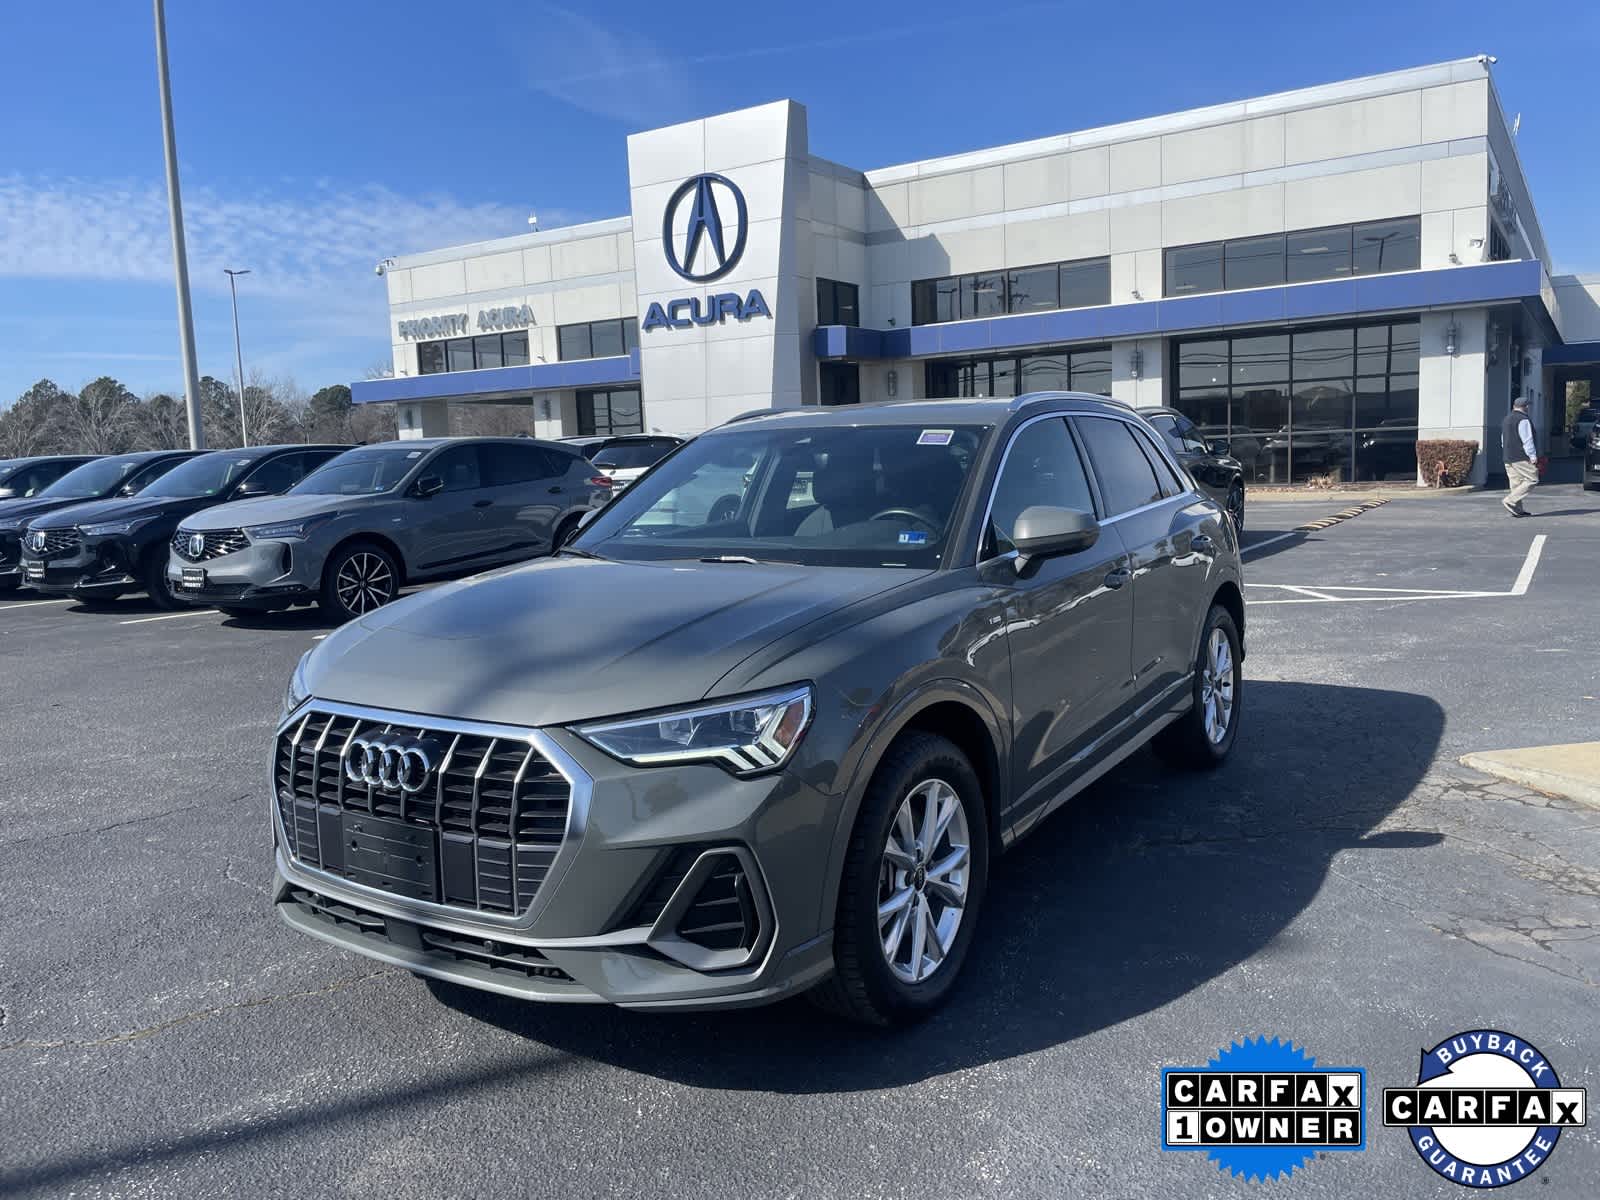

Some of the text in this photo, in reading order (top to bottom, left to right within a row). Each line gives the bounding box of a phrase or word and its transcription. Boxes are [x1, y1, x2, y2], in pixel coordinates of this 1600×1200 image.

[398, 304, 537, 341] PRIORITY ACURA
[641, 289, 773, 332] ACURA
